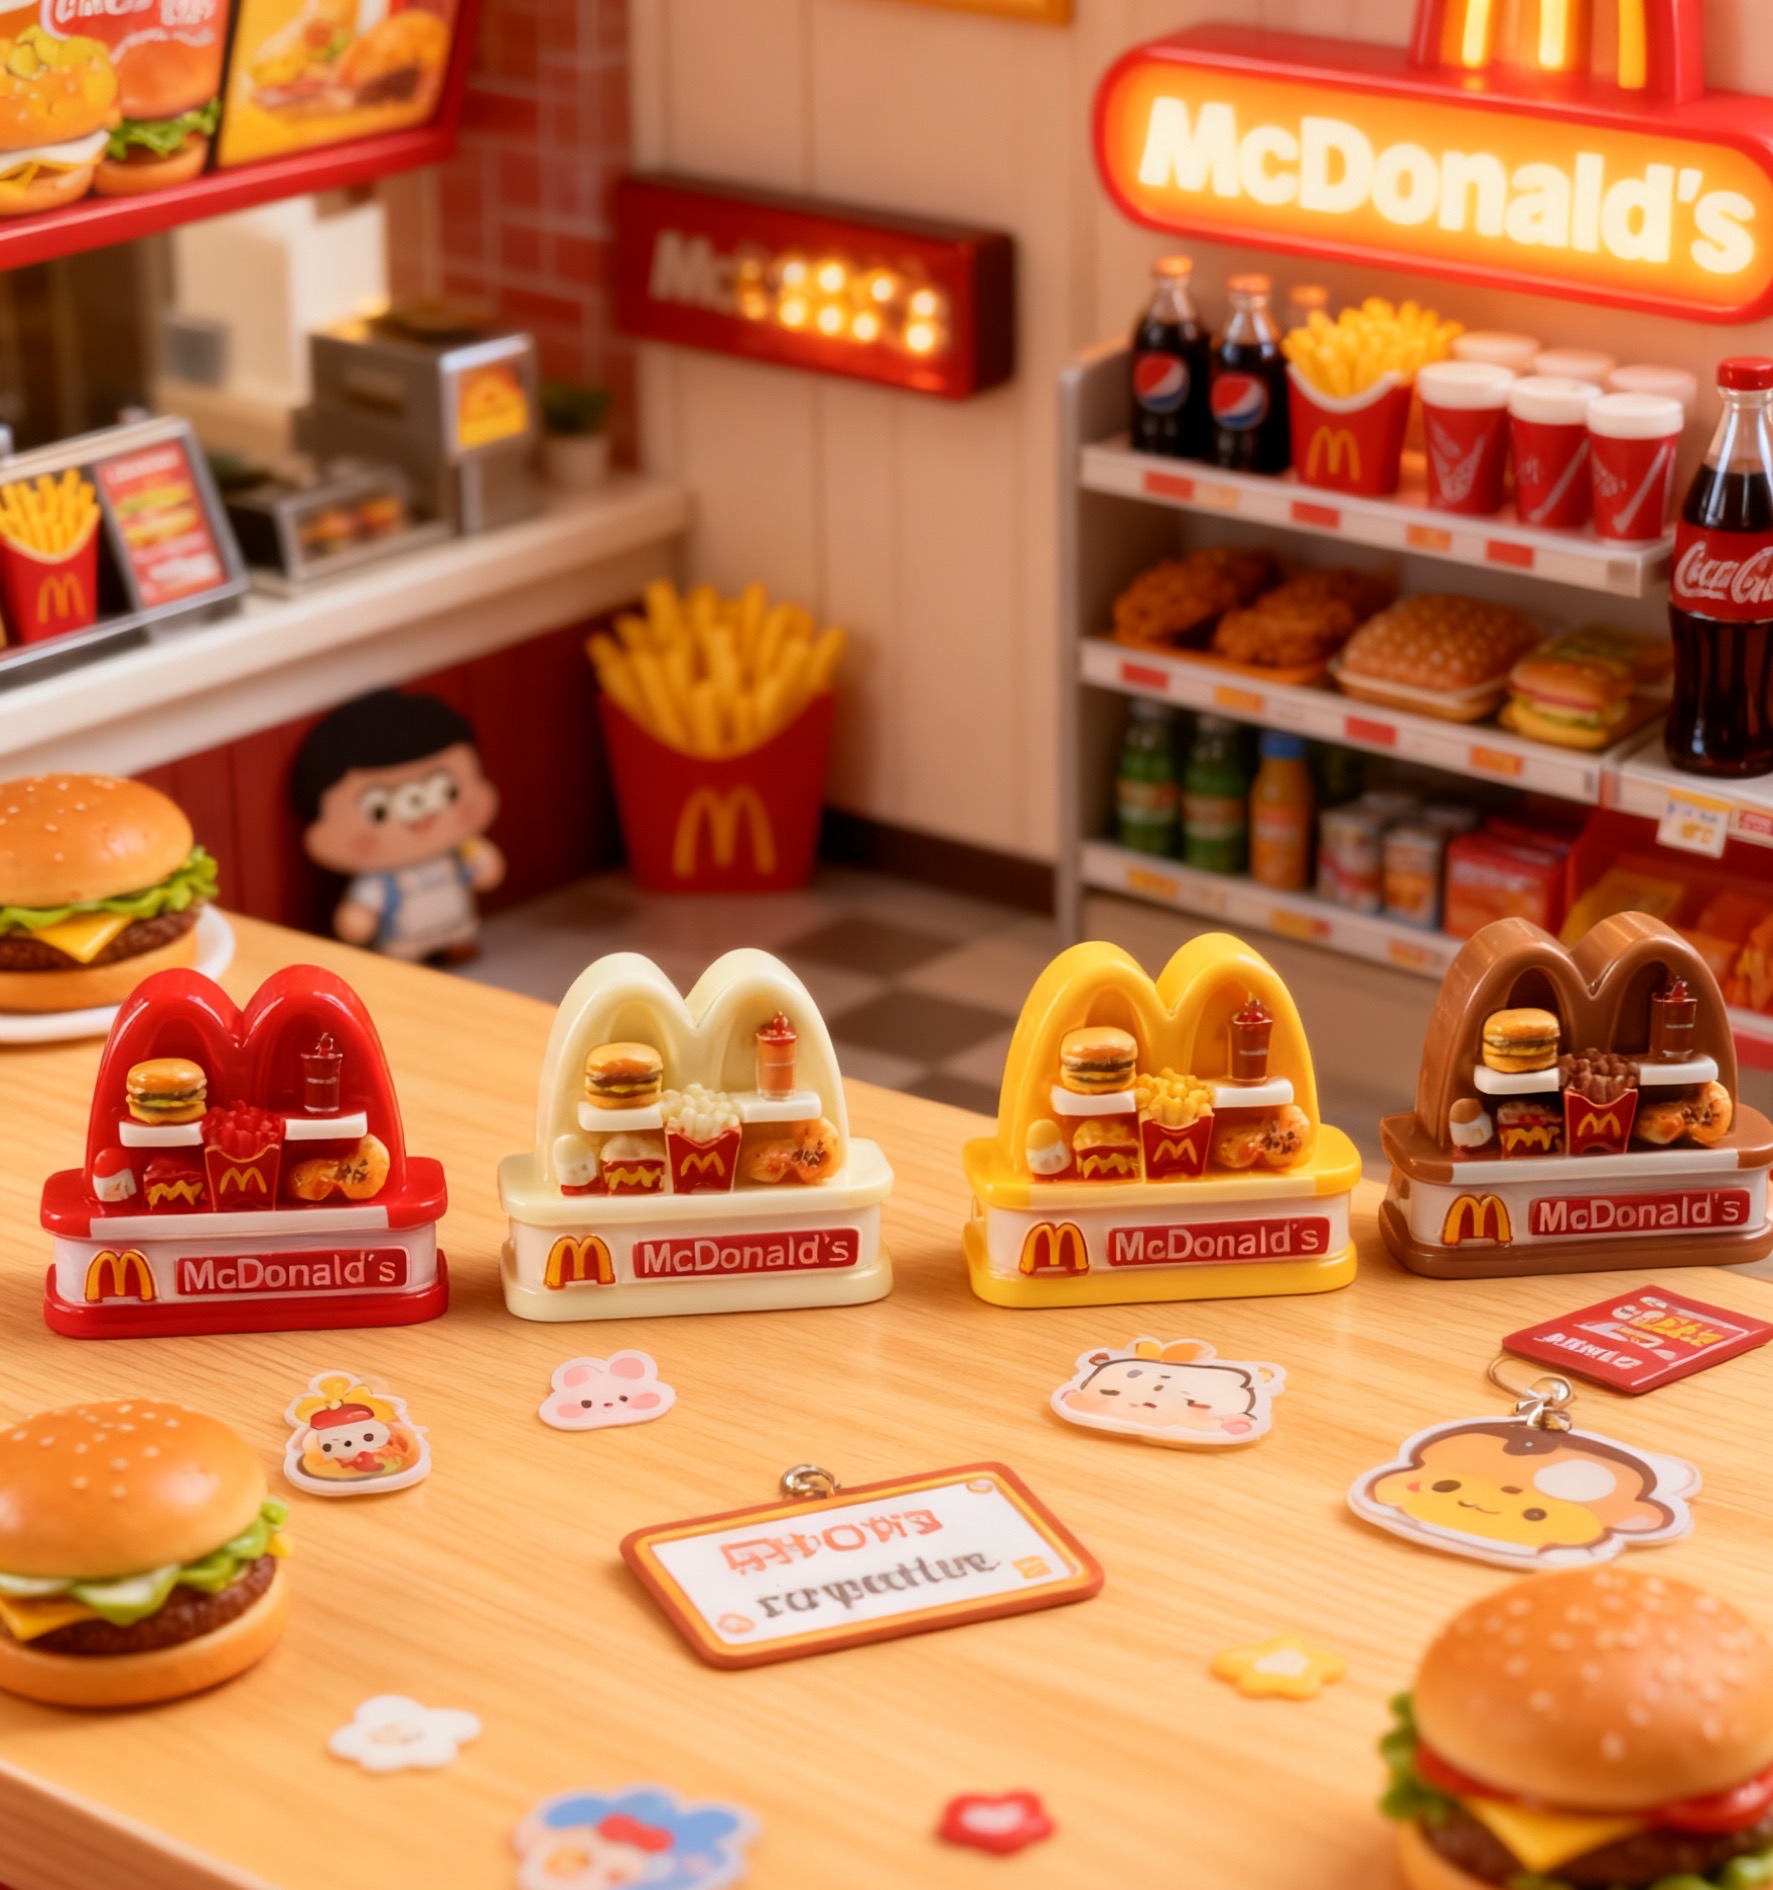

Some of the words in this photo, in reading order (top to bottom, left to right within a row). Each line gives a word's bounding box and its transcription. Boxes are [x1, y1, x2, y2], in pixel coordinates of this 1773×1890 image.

[1138, 97, 1756, 273] McDonald's
[643, 1233, 849, 1273] McDonald's
[1115, 1220, 1319, 1261] McDonald's
[184, 1251, 396, 1292] McDonald's
